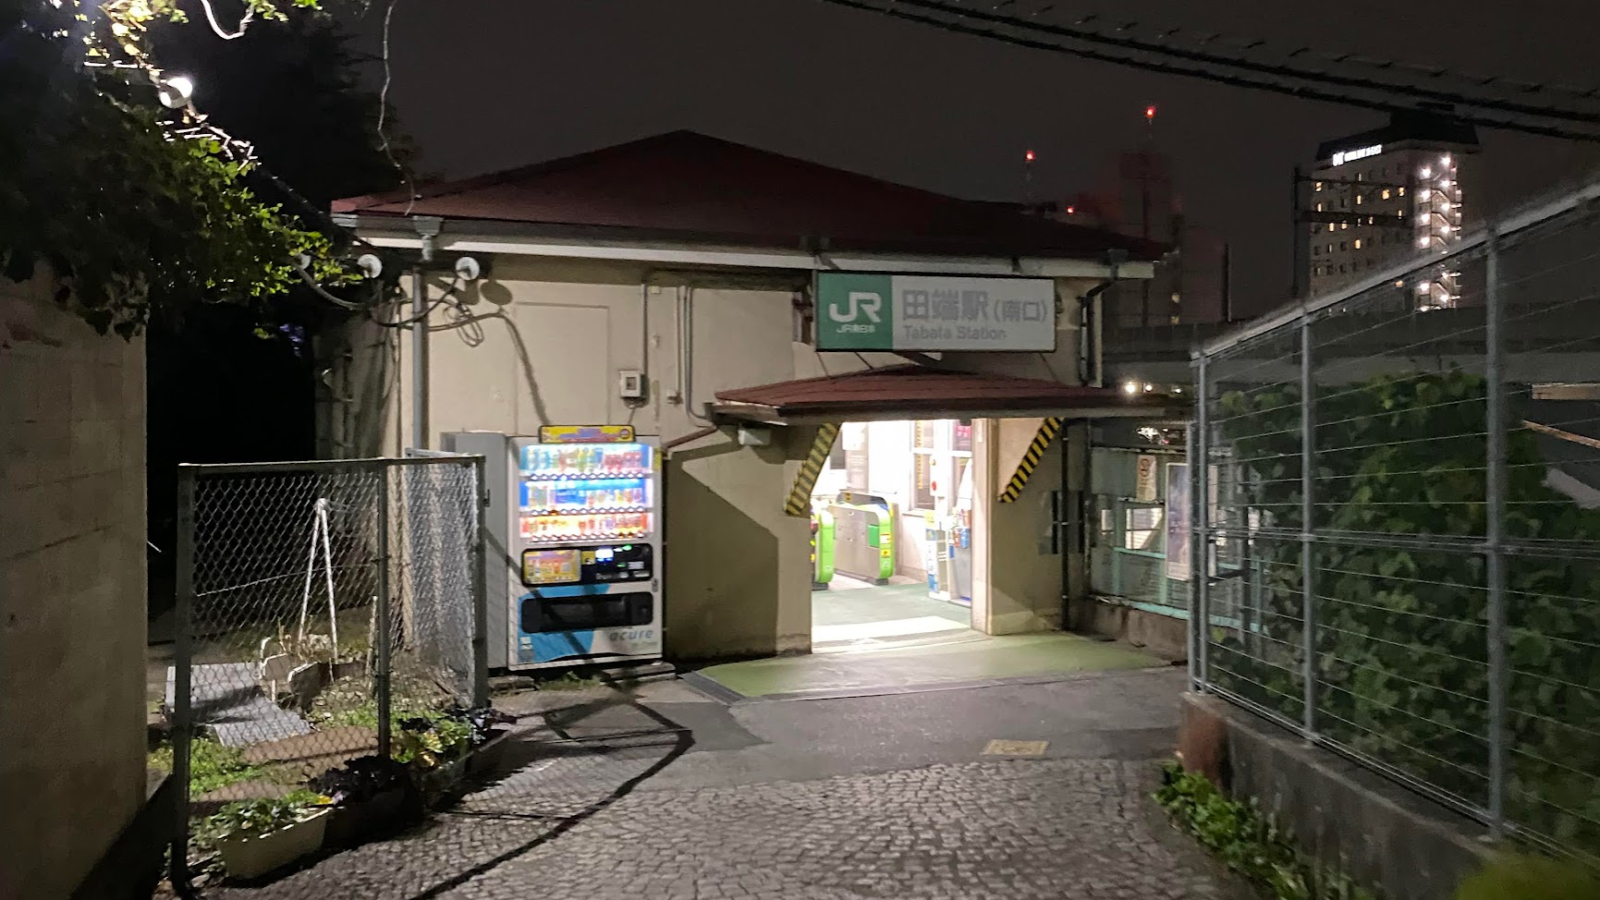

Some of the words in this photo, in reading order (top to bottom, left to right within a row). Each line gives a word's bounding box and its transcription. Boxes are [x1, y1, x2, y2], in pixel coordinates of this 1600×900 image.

[828, 291, 883, 323] JR
[904, 325, 952, 339] Tabata
[957, 327, 1007, 340] Station
[609, 630, 653, 642] acure
